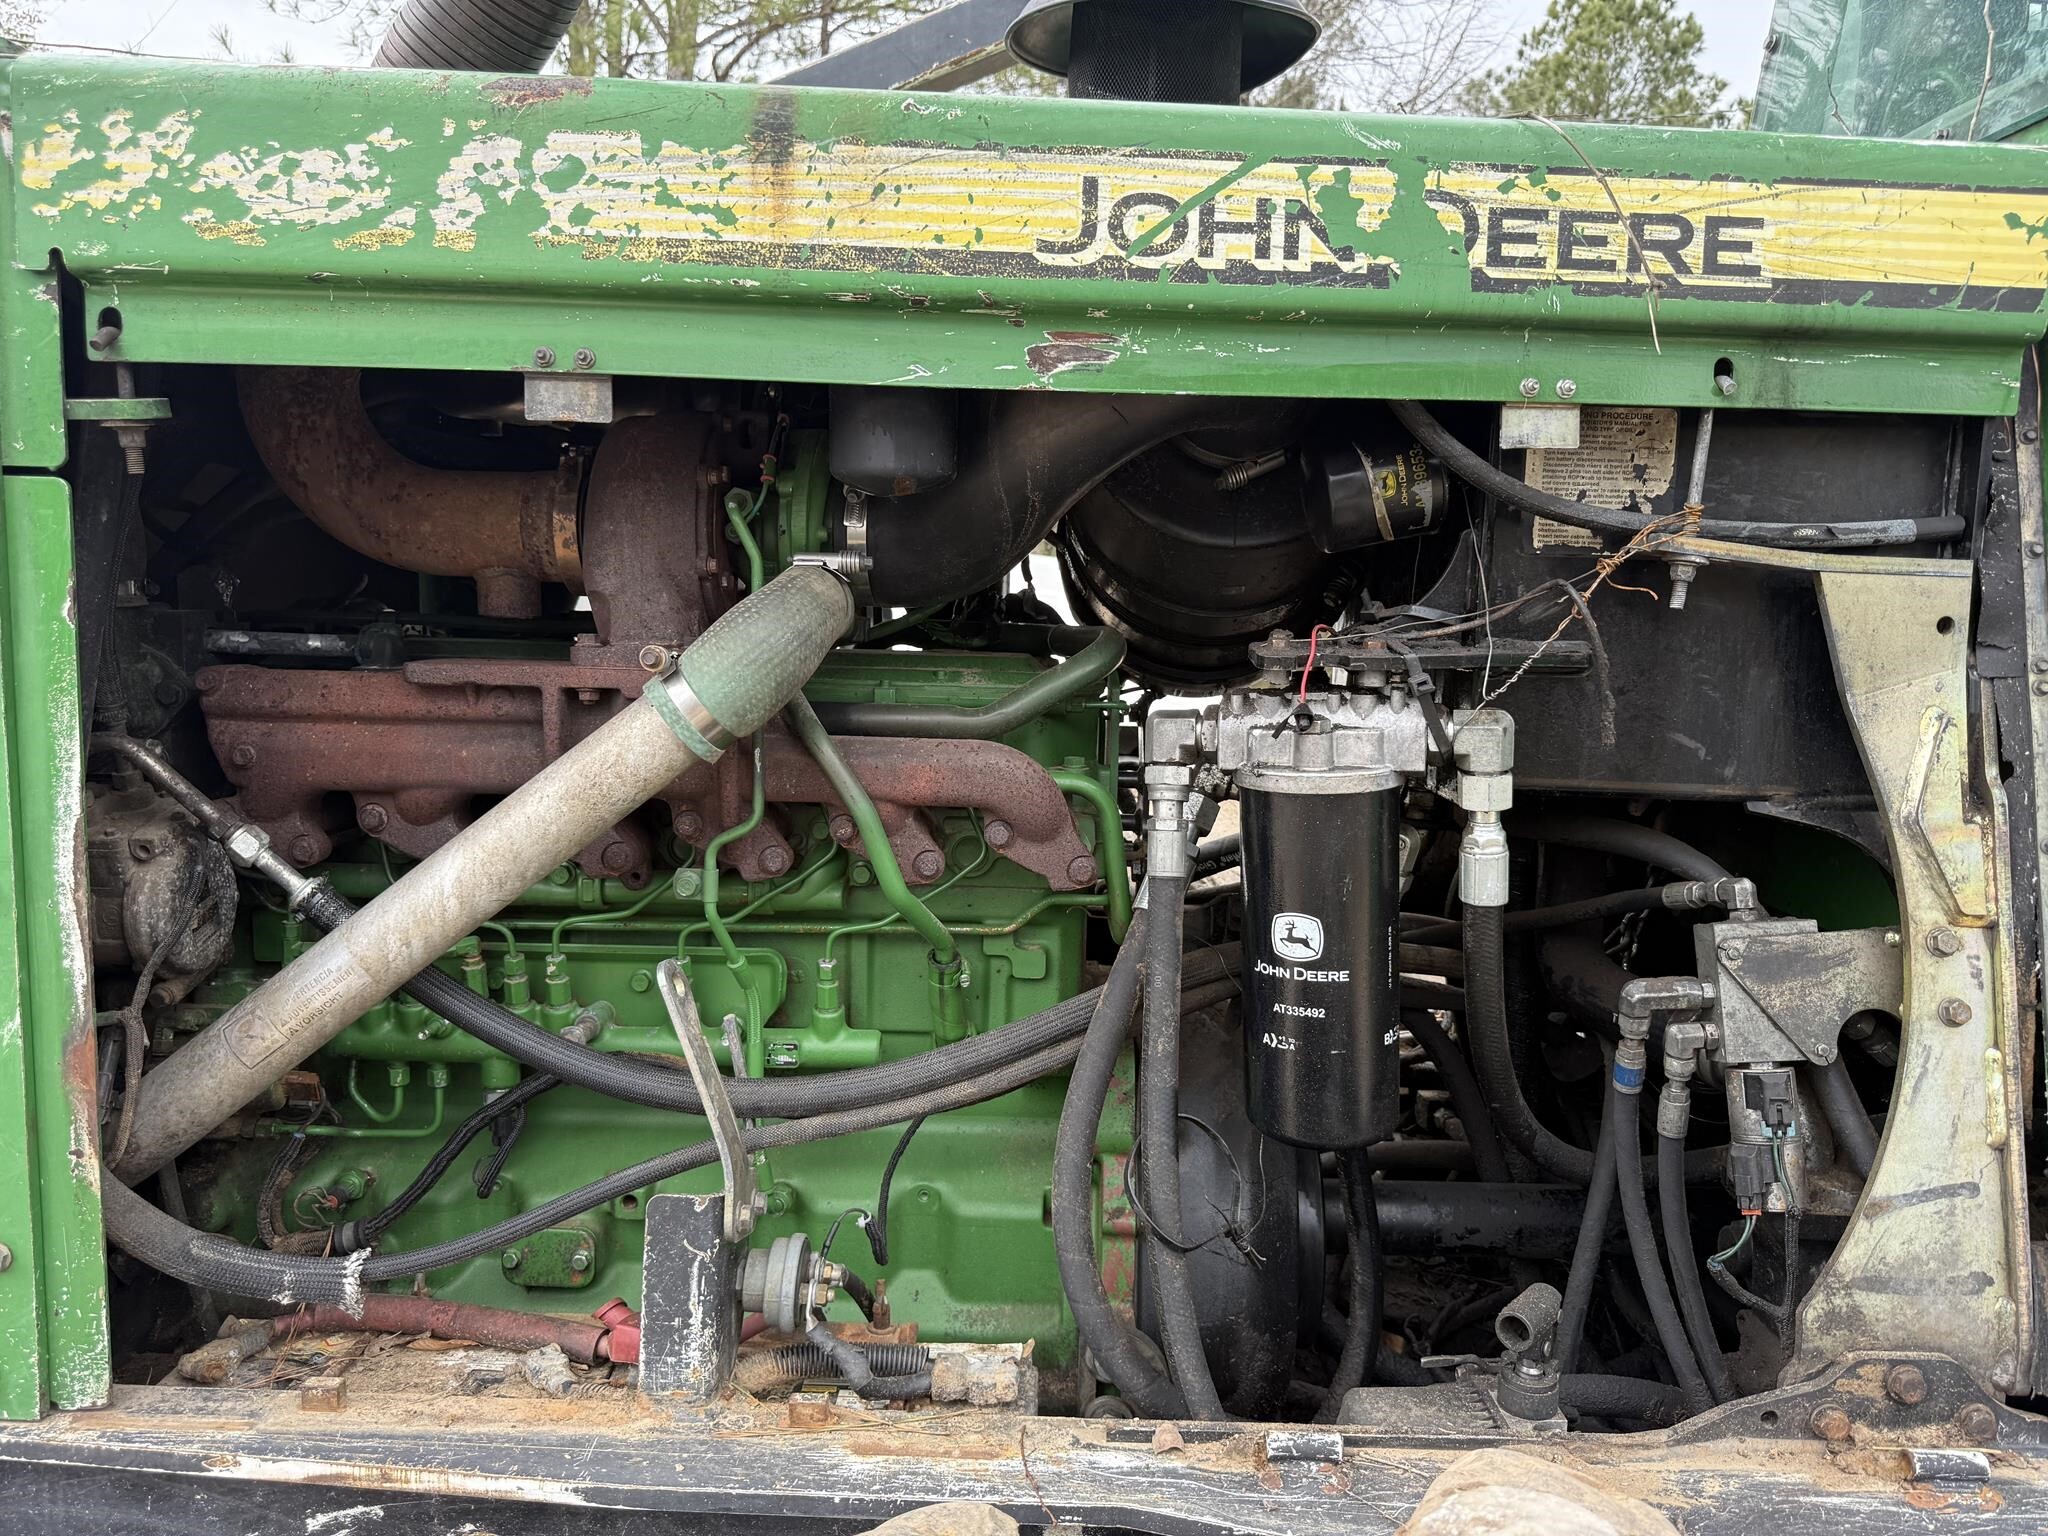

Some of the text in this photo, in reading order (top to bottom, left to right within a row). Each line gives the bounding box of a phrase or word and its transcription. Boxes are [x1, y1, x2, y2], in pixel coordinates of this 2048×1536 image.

[1601, 412, 1654, 420] PROCEDURE
[1395, 454, 1408, 506] JOHN DEERE
[1254, 960, 1350, 982] JOHN DEERE
[296, 991, 344, 1033] VORSICHT
[1273, 1002, 1326, 1018] AT335492
